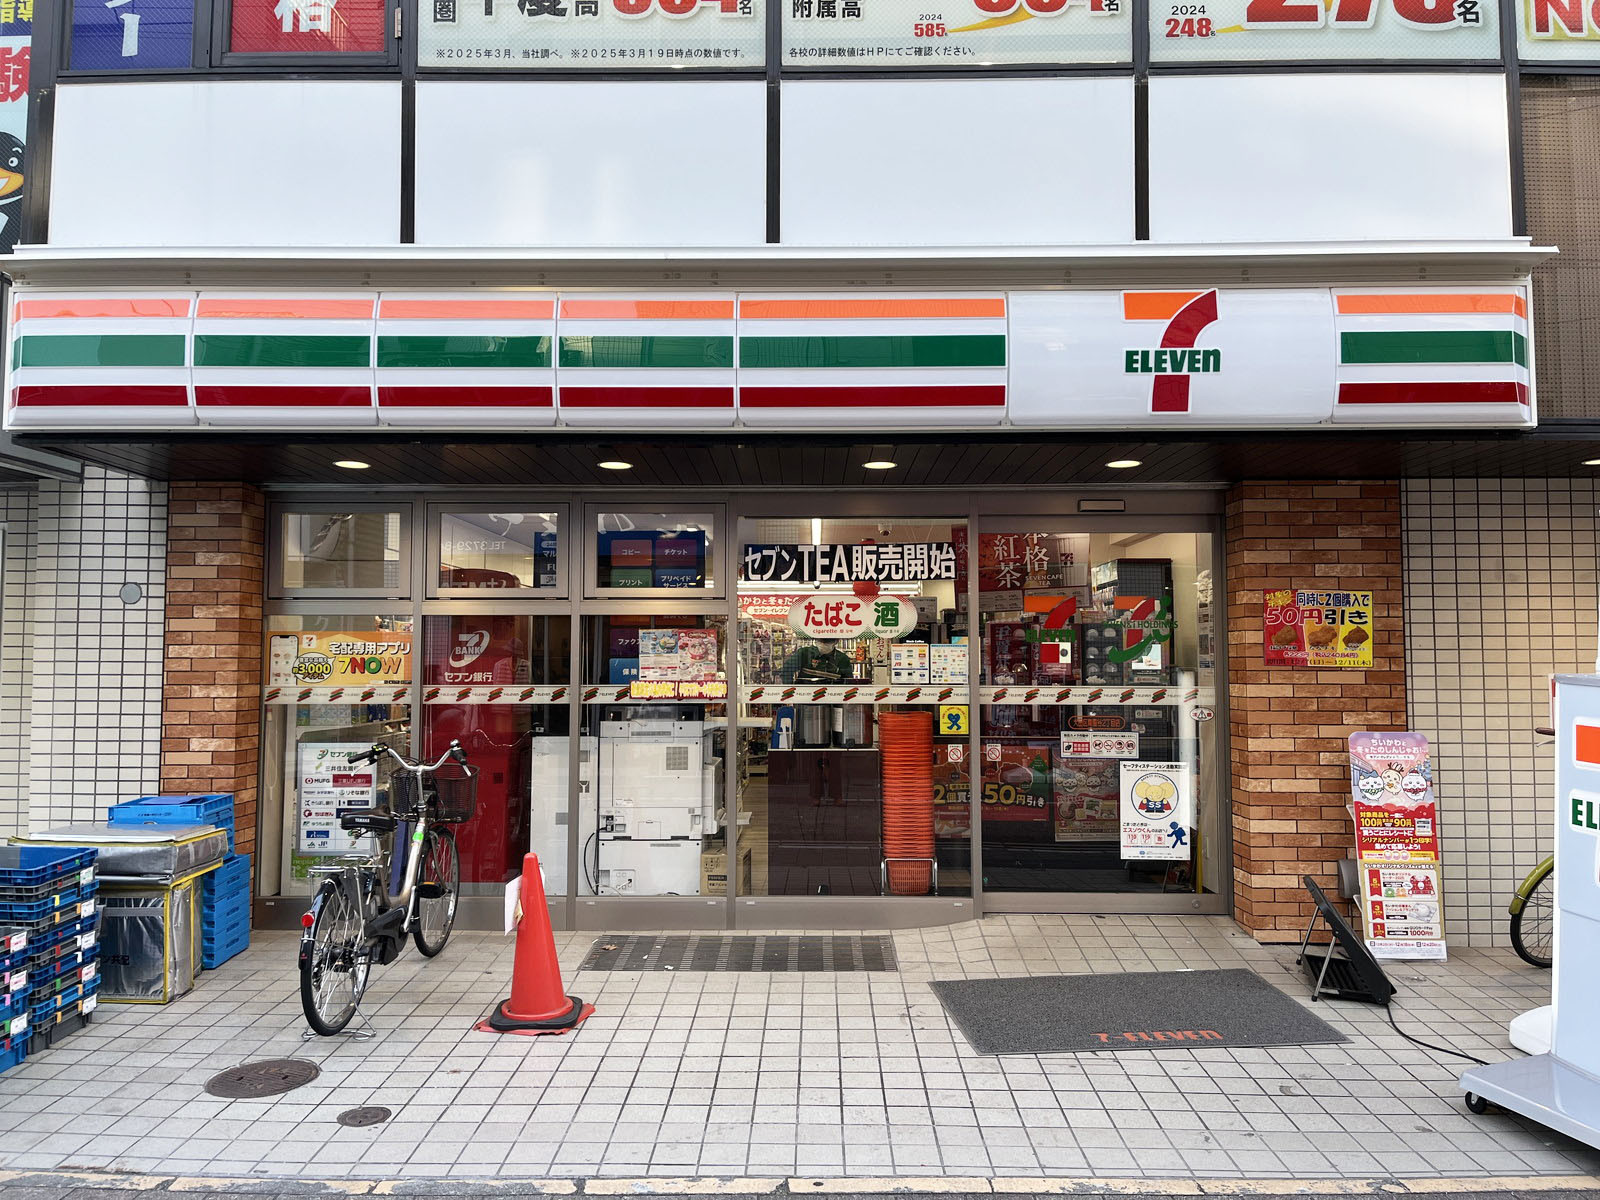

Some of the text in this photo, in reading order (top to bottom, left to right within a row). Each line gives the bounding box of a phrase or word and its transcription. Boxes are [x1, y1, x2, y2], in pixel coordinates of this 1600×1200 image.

[791, 0, 862, 18] 附属高
[919, 13, 943, 21] 2024
[1171, 5, 1207, 15] 2024
[789, 46, 976, 58] 各校の詳細数値はHPにてご確認ください。
[663, 548, 688, 556] チケット
[744, 543, 957, 582] セブンTEA販売開始
[993, 534, 1022, 589] 紅茶
[1296, 592, 1370, 608] 同時に2個購入で
[804, 601, 862, 628] たばこ
[874, 601, 899, 627] 酒
[1265, 607, 1370, 626] 50円引き
[329, 641, 412, 656] 宅配専用アプリ
[455, 646, 482, 656] BANK
[444, 671, 493, 682] セブン銀行
[1572, 798, 1600, 831] EL
